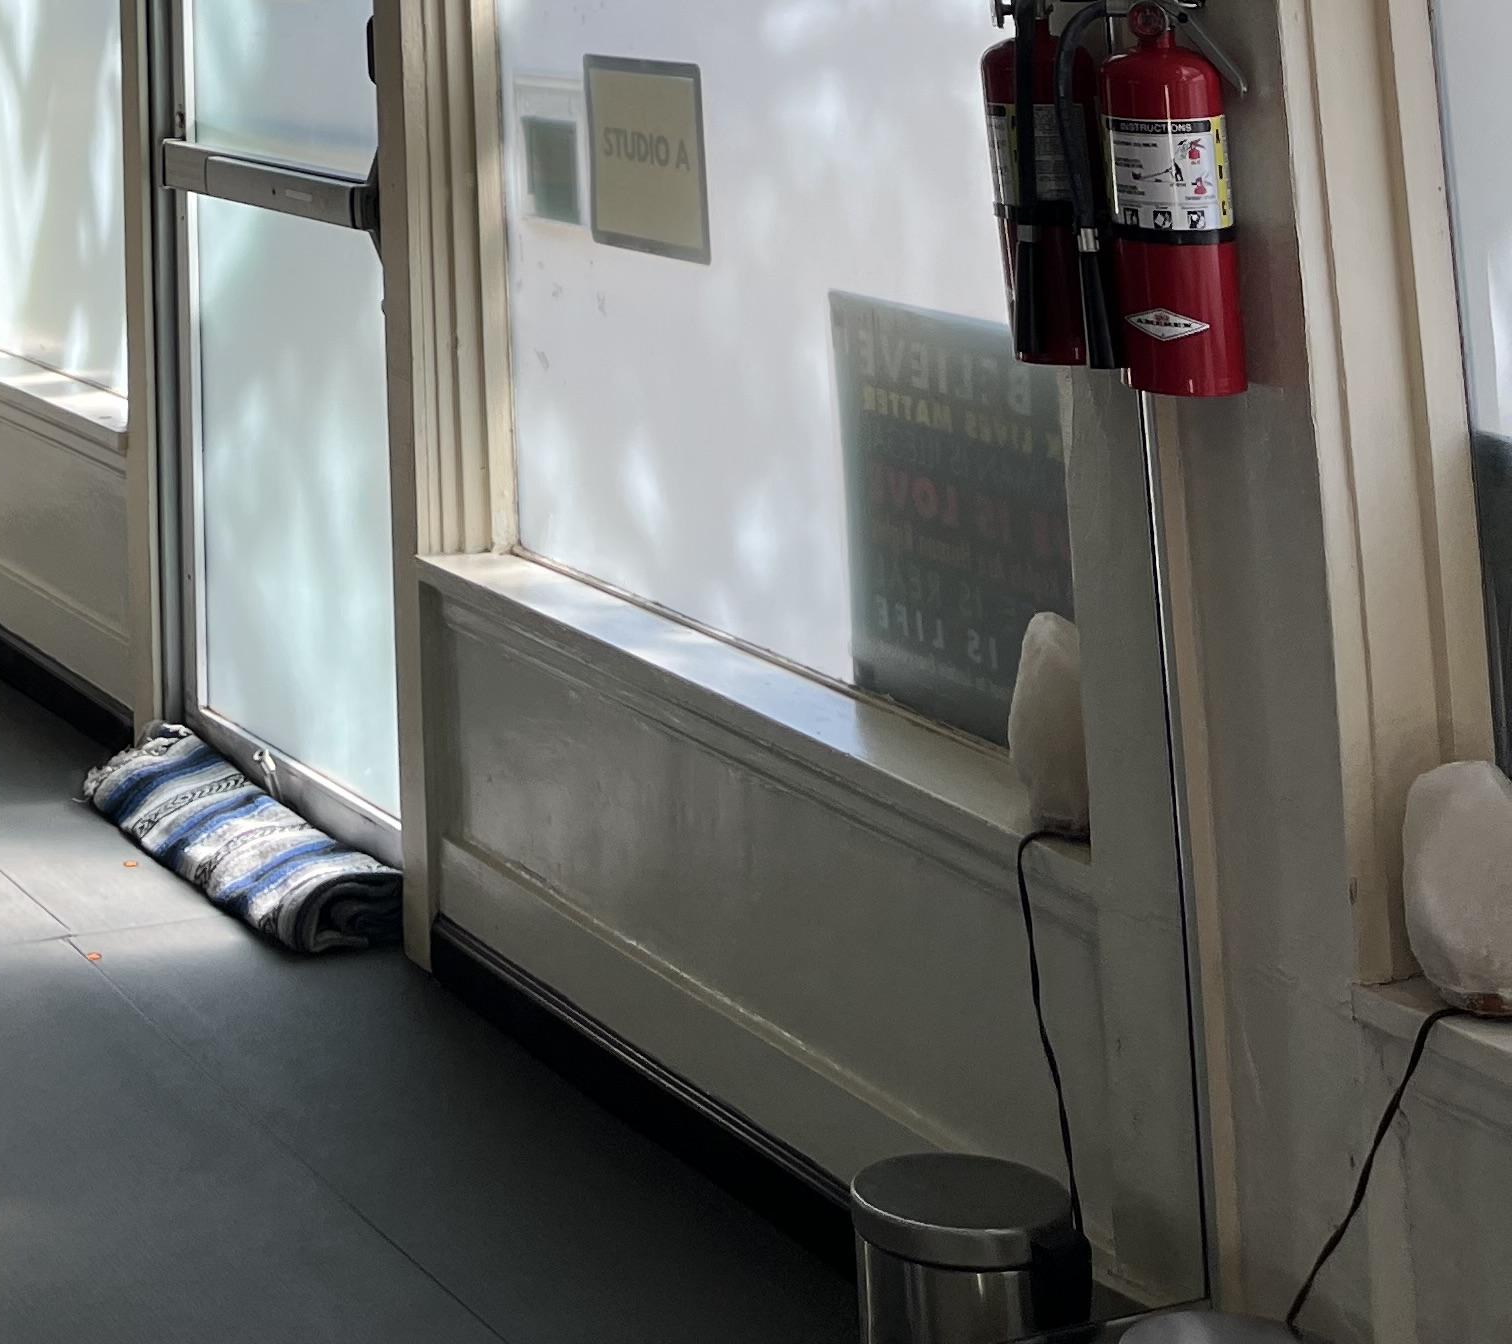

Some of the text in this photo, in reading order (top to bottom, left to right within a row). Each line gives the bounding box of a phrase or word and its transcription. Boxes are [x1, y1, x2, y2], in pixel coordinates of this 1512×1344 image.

[1119, 121, 1192, 133] INSTRUCTONS
[602, 126, 691, 172] STUDIO A
